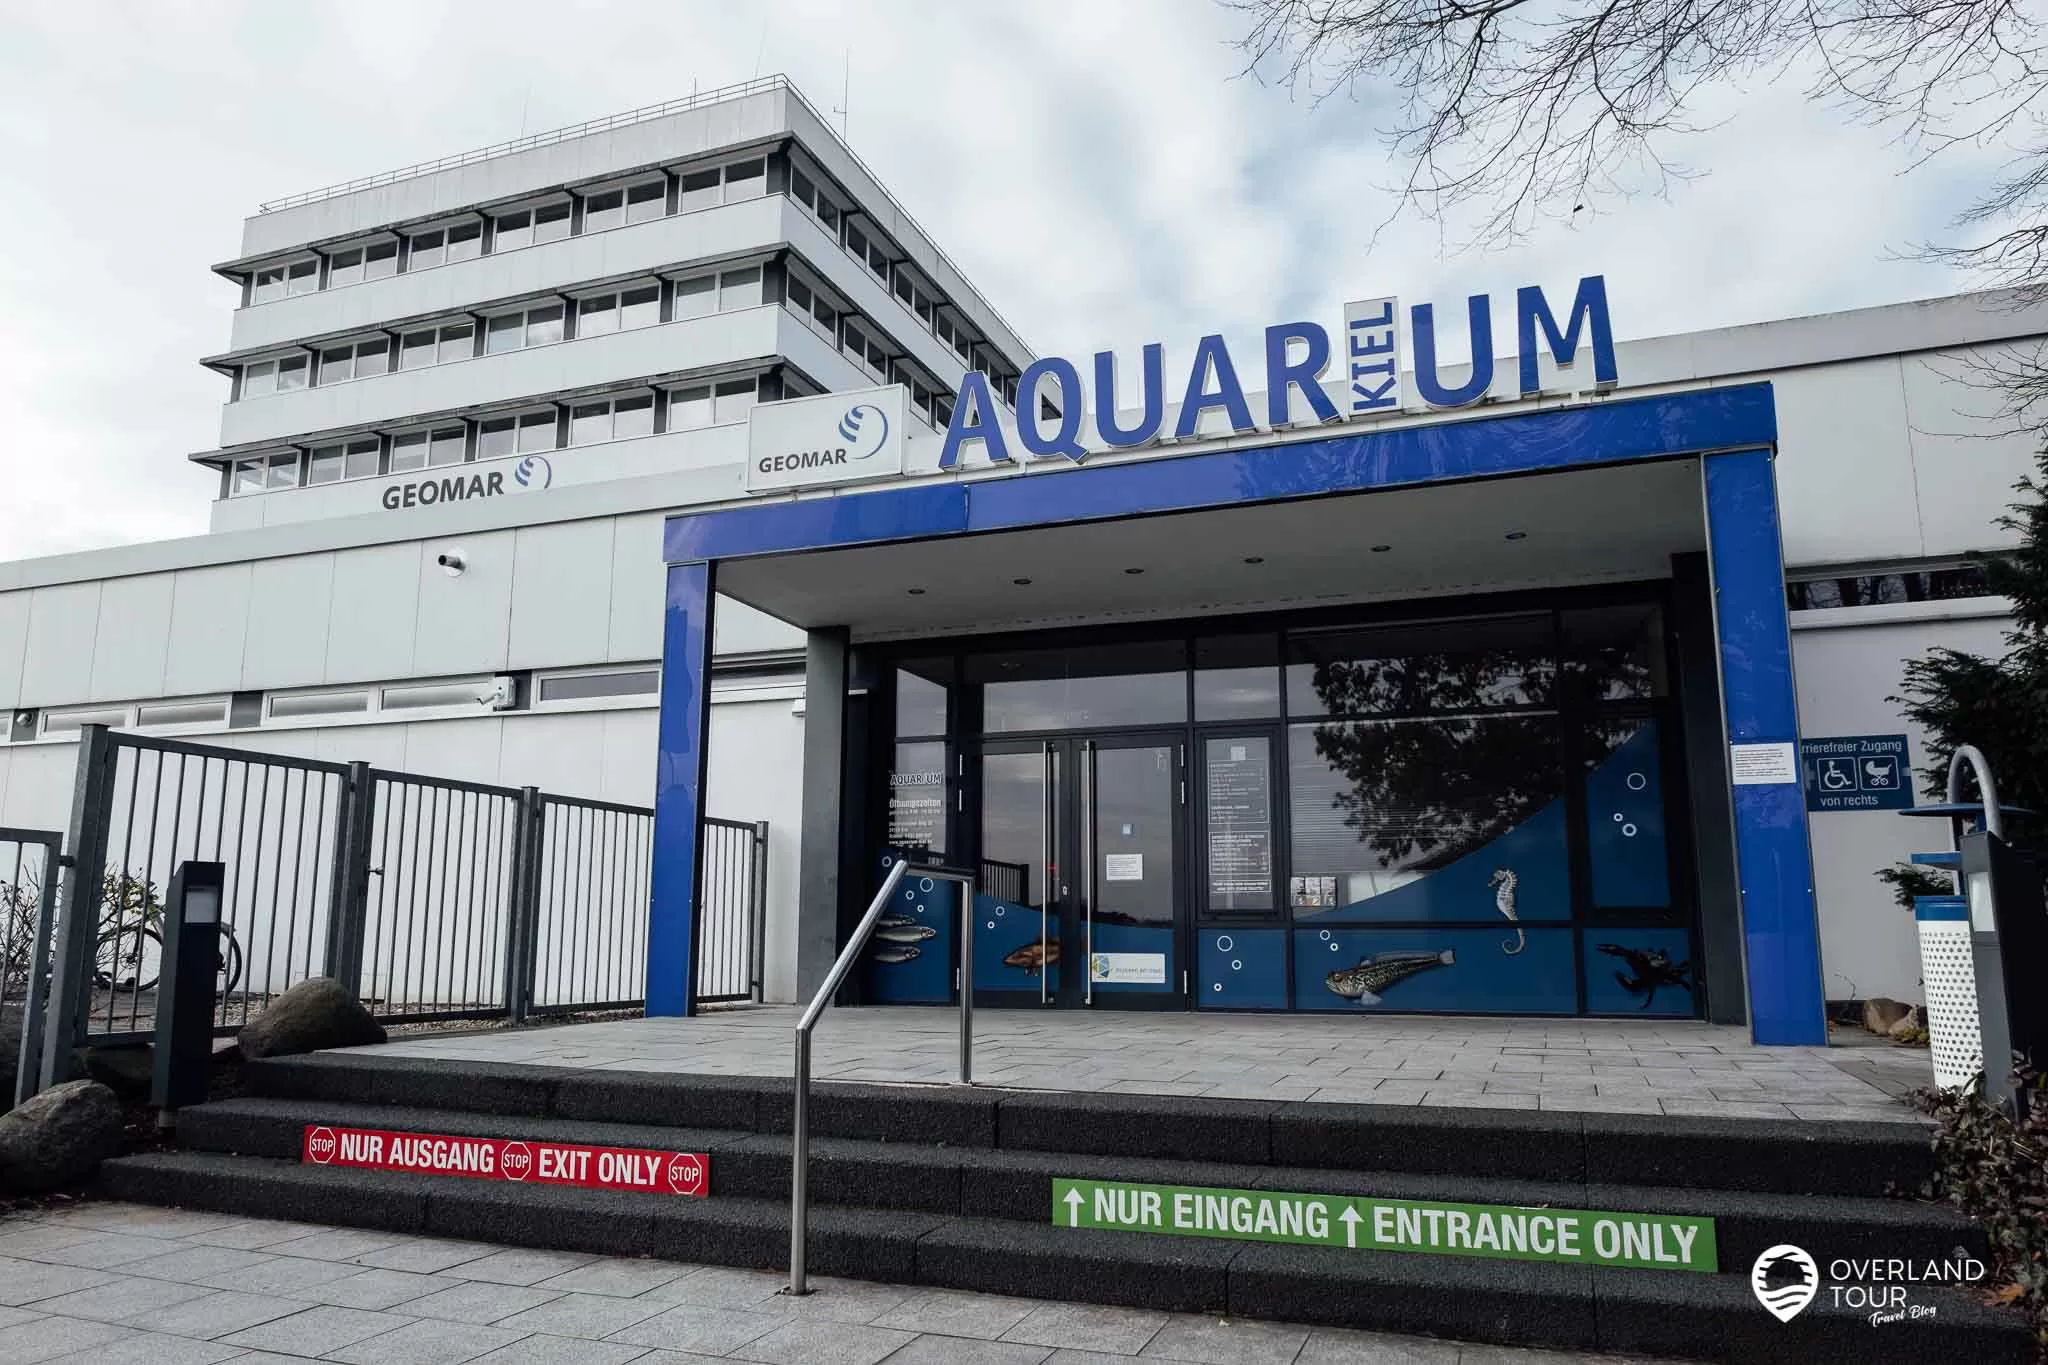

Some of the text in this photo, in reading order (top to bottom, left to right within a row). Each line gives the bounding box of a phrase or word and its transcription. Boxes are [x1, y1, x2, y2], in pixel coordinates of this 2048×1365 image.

[1349, 301, 1398, 410] KIEL
[759, 448, 848, 473] GEOMAR
[382, 471, 505, 510] GEOMAR
[1859, 740, 1903, 753] Zugang
[1820, 794, 1879, 807] von rechts
[311, 1133, 700, 1186] STOP NUR AUSGANG STOP EXIT ONLY STOP
[1094, 1187, 1699, 1264] NUR EINGANG ENTRANCE ONLY
